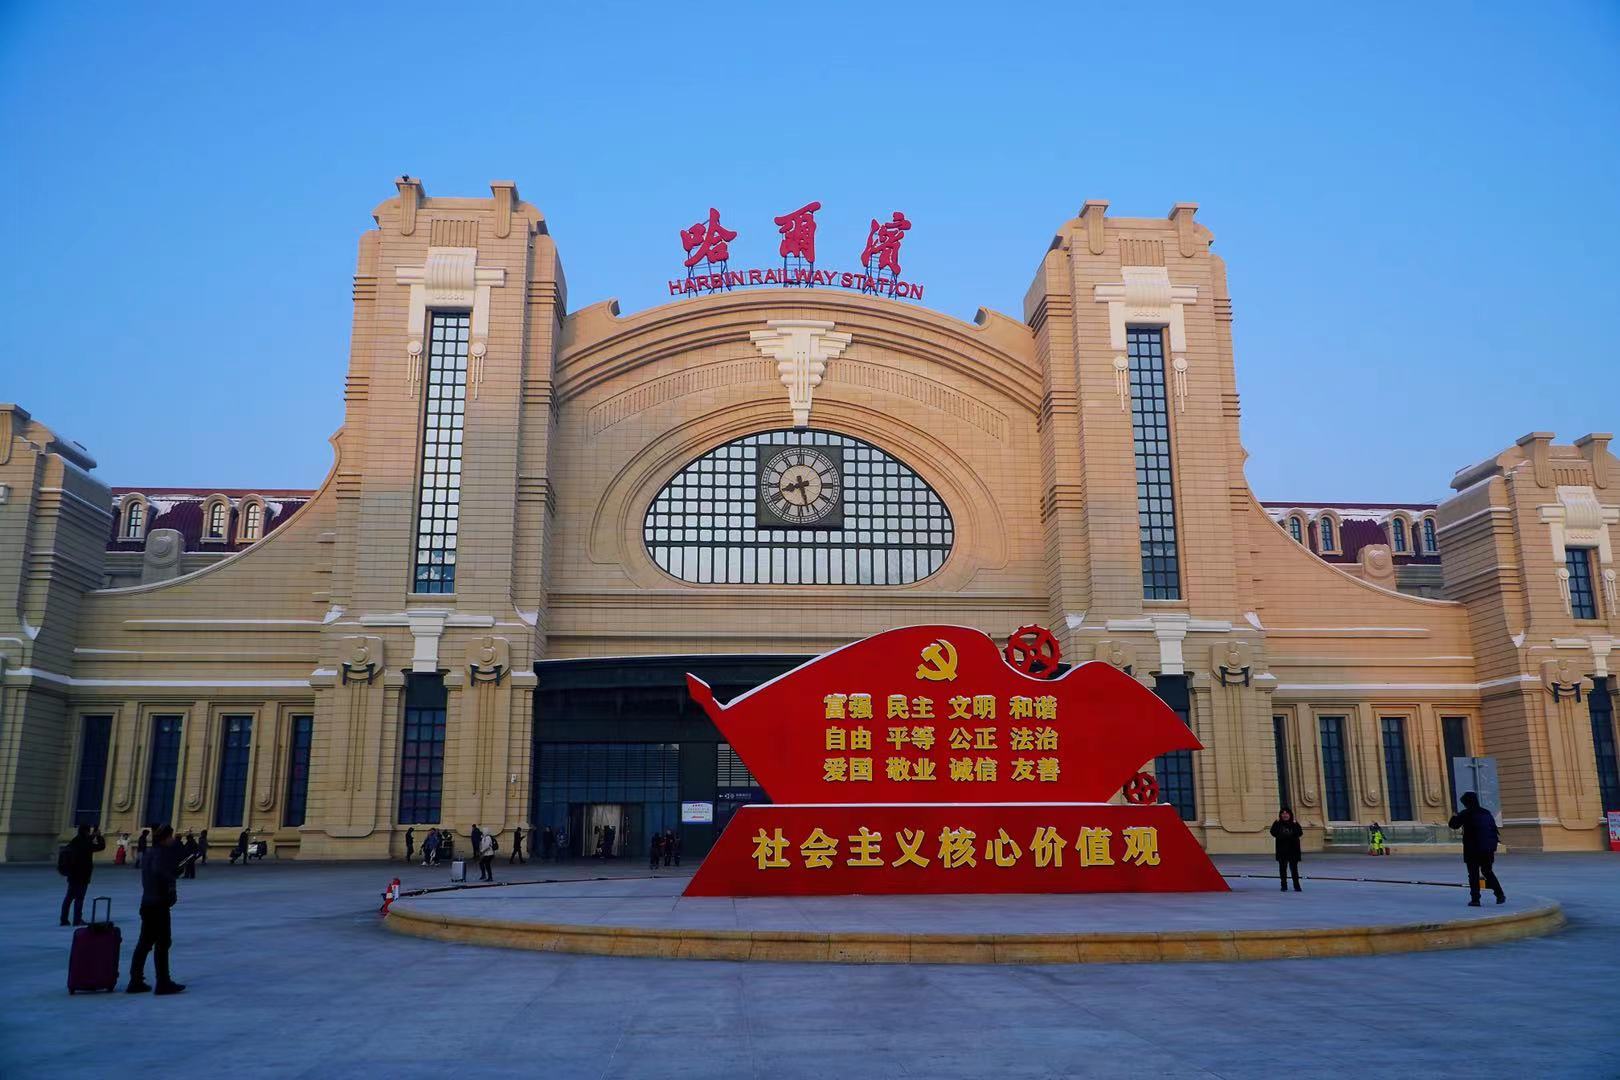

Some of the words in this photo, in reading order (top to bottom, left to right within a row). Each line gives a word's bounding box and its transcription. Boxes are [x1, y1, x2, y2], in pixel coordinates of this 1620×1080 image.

[668, 270, 745, 296] HARBIN
[748, 268, 838, 286] RAILWAY
[841, 272, 924, 300] STATION
[824, 693, 873, 719] 富强
[887, 694, 935, 719] 民主
[948, 695, 996, 719] 文明
[1009, 695, 1057, 719] 和谐
[826, 726, 872, 750] 自由
[886, 726, 936, 750] 平等
[949, 727, 998, 750] 公正
[1010, 726, 1058, 750] 法治
[823, 757, 873, 781] 爱国
[886, 757, 937, 781] 敬业
[949, 757, 998, 781] 诚信
[1011, 757, 1060, 781] 友善
[752, 826, 1161, 869] 社会主义核心价值观
